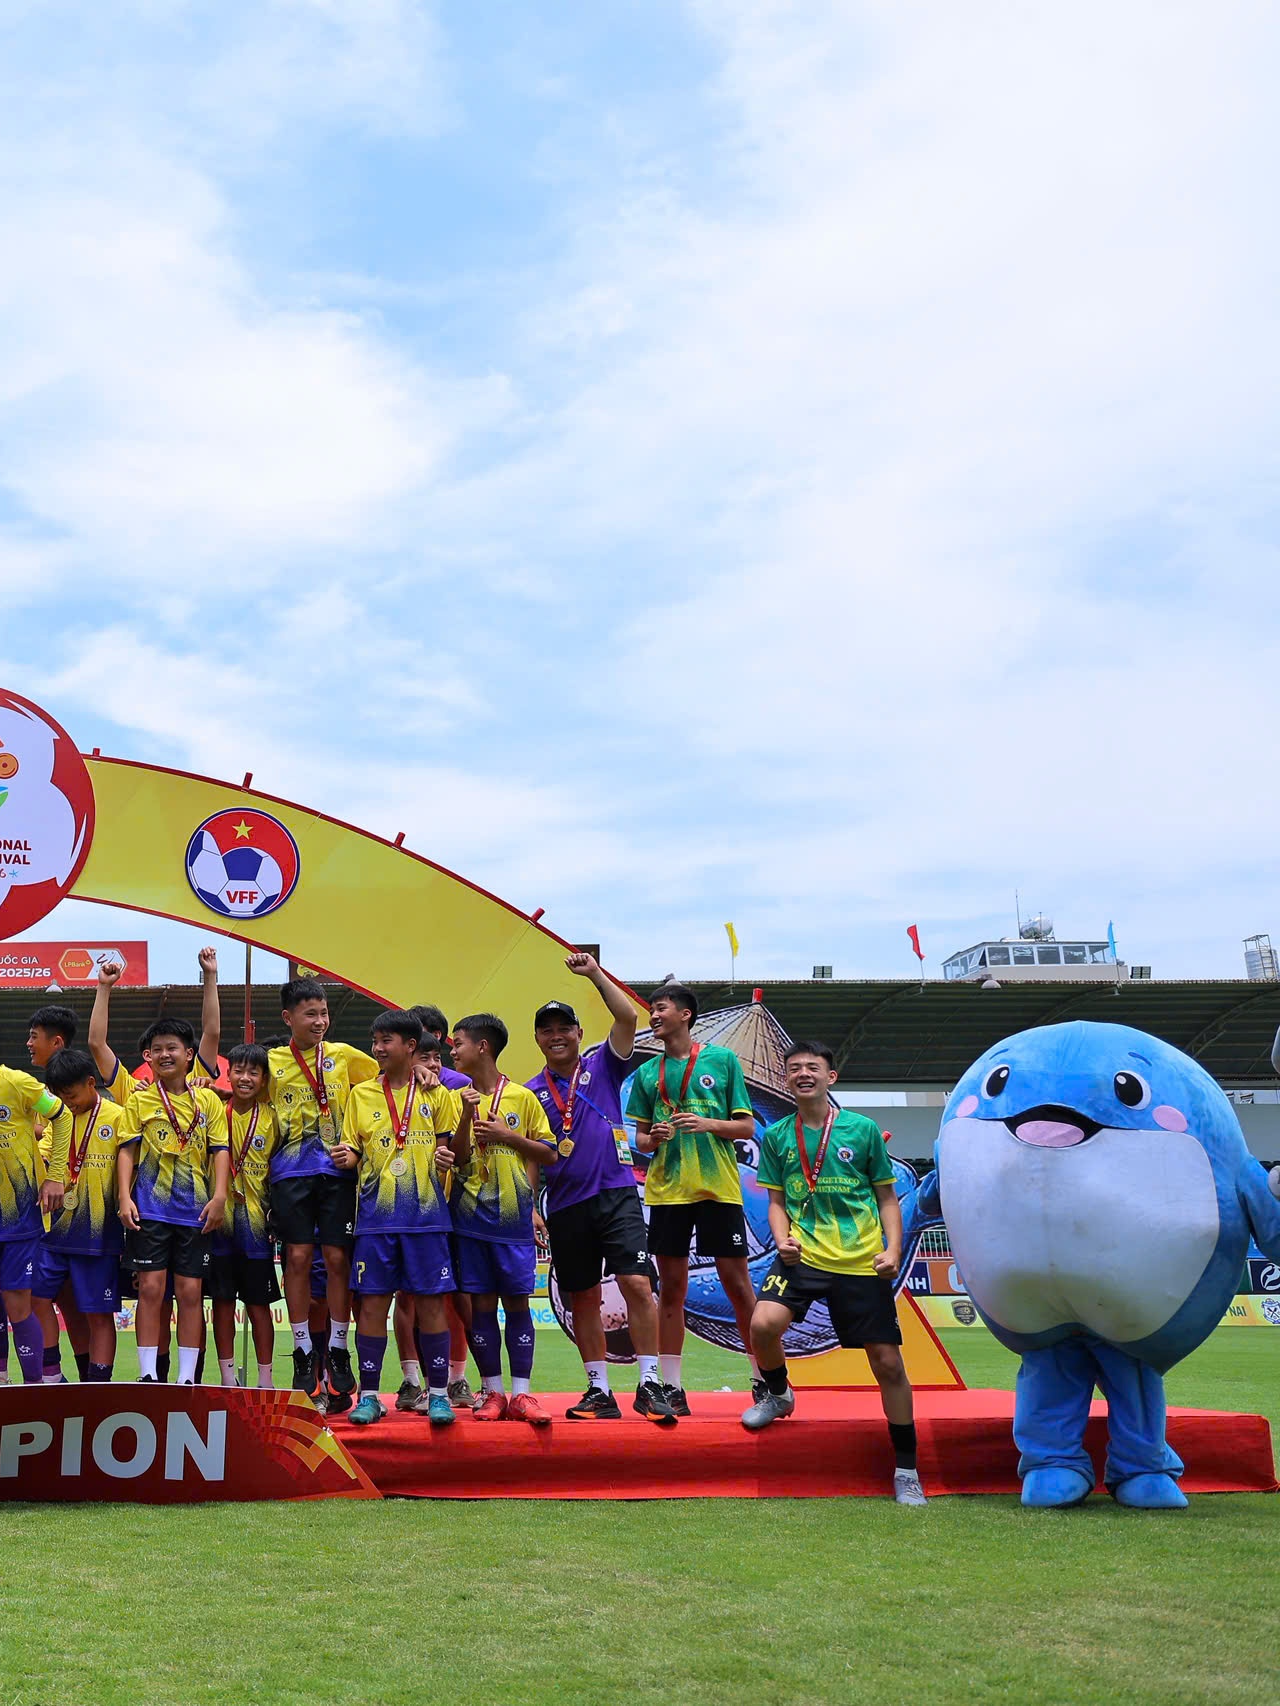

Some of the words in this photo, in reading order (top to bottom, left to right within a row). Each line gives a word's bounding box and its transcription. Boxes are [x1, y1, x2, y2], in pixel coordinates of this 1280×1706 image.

[226, 891, 258, 904] VFF
[21, 956, 39, 965] GIA
[0, 967, 52, 979] 2025/26
[817, 1176, 860, 1186] EGETEXCO
[761, 1275, 789, 1297] 34
